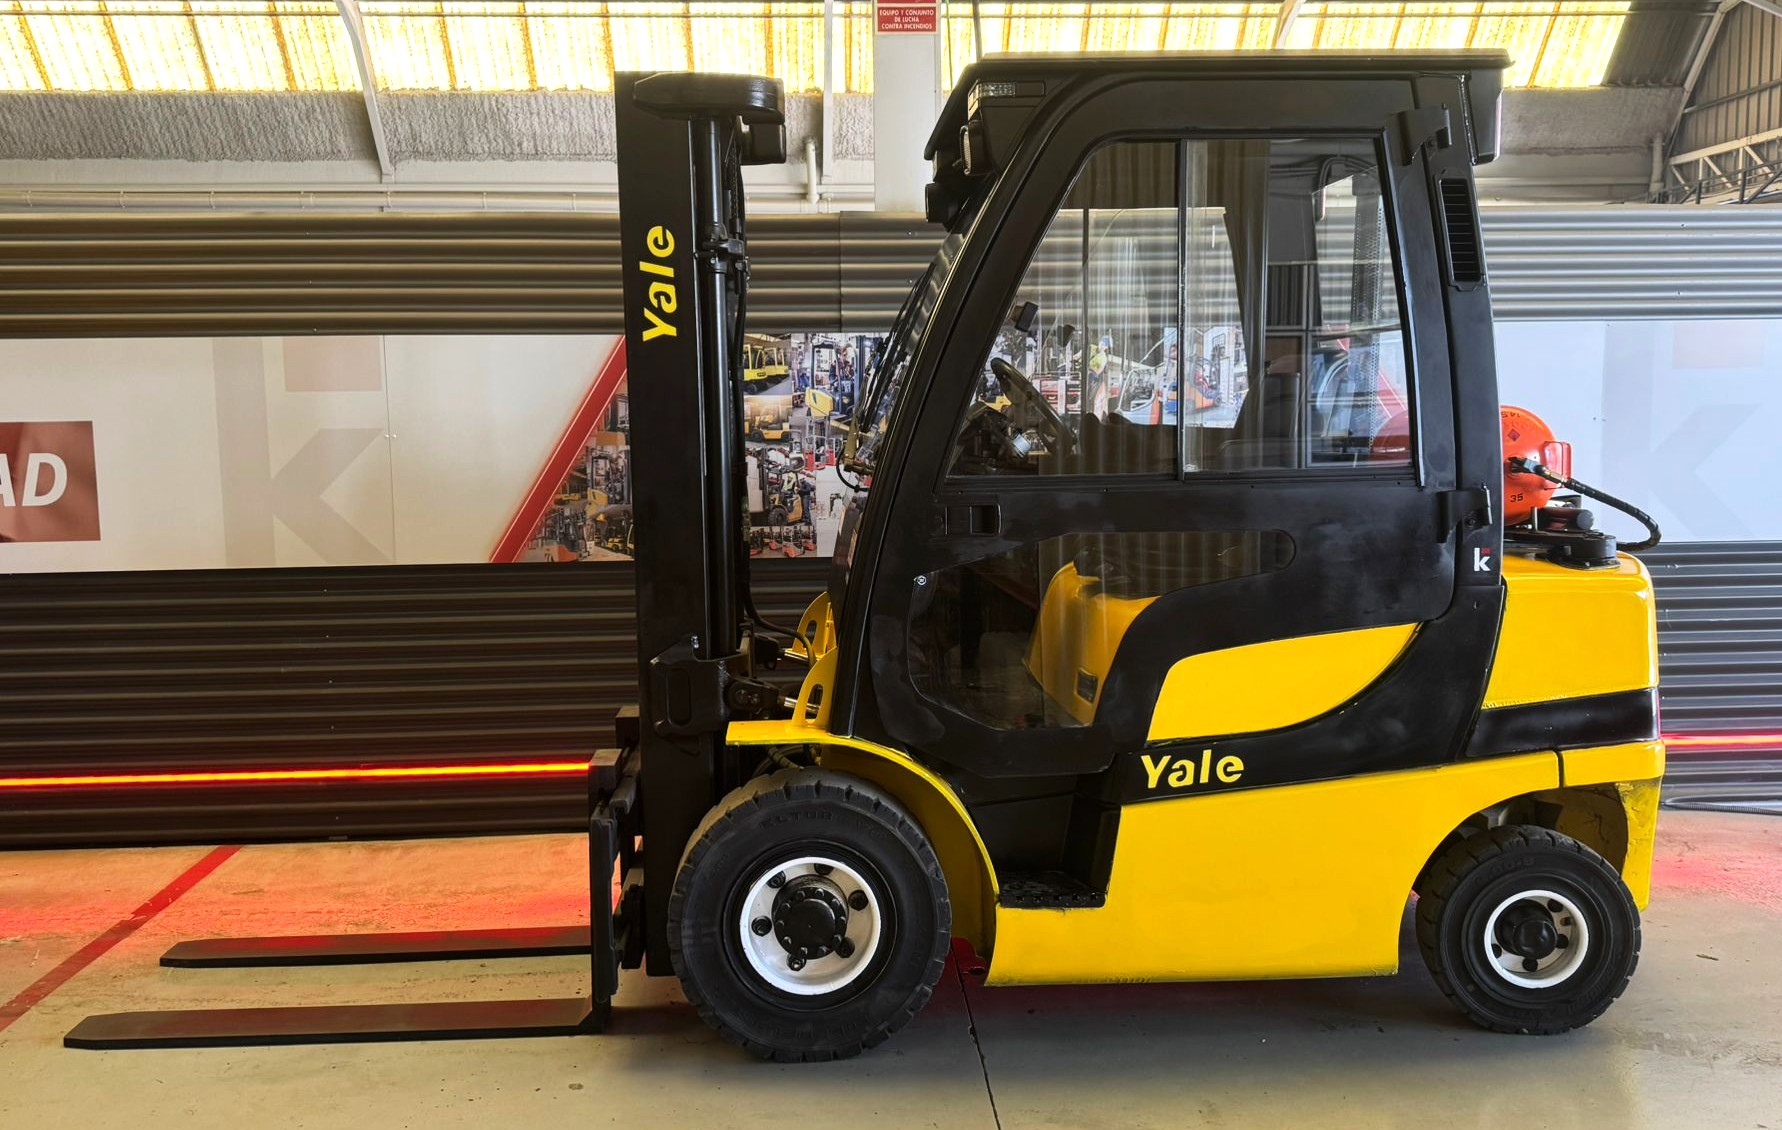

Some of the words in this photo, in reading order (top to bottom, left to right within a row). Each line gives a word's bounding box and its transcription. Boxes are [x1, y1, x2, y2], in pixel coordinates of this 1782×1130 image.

[639, 225, 678, 342] Yale
[1510, 493, 1524, 503] 35
[1473, 547, 1491, 572] k
[1140, 748, 1245, 789] Yale
